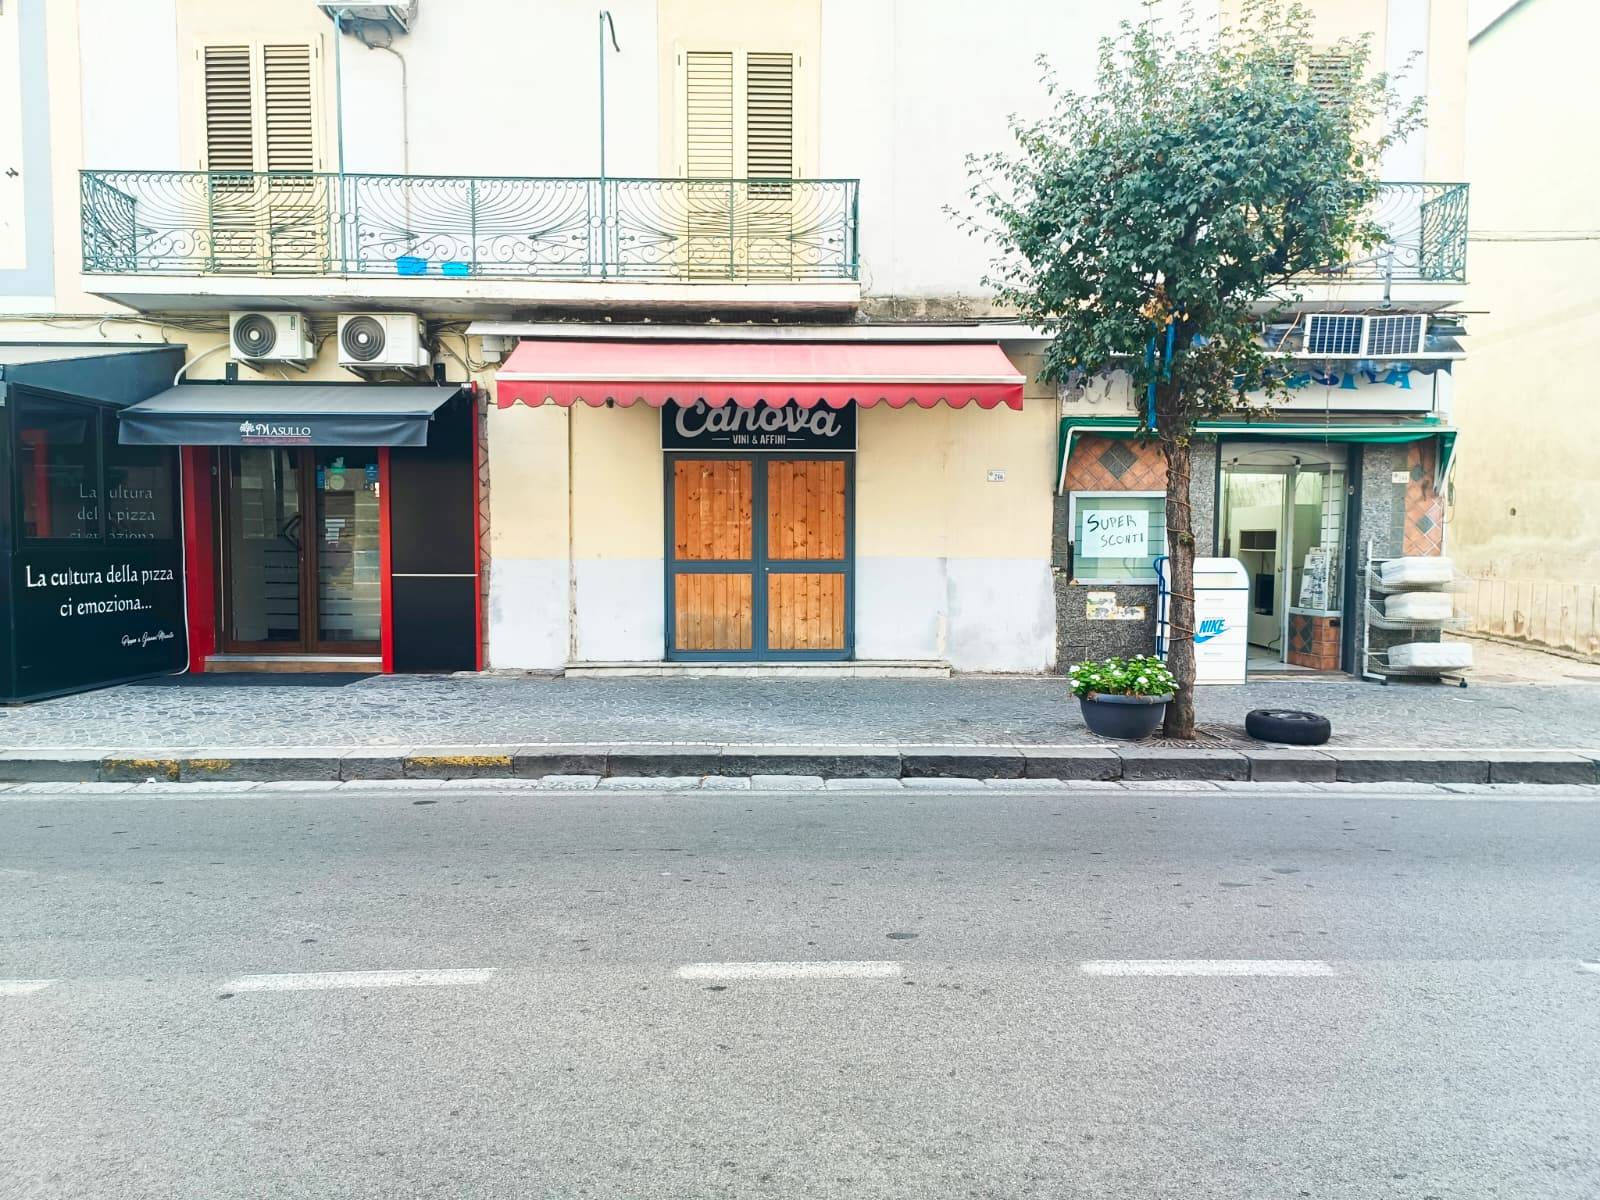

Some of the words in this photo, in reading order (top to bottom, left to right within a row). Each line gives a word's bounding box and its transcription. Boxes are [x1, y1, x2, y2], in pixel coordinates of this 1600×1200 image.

[676, 401, 842, 438] Canova
[733, 434, 750, 445] VINI
[751, 435, 758, 445] &
[760, 434, 786, 445] AFFINI
[109, 483, 153, 499] ultura
[1087, 514, 1137, 532] SUPER
[1101, 533, 1144, 547] SCONTI
[25, 565, 48, 588] La
[50, 567, 103, 586] cultura
[106, 564, 138, 583] della
[141, 569, 174, 585] pizza
[60, 597, 73, 617] ci
[77, 594, 152, 615] emoziona...
[1199, 619, 1225, 633] NIKE
